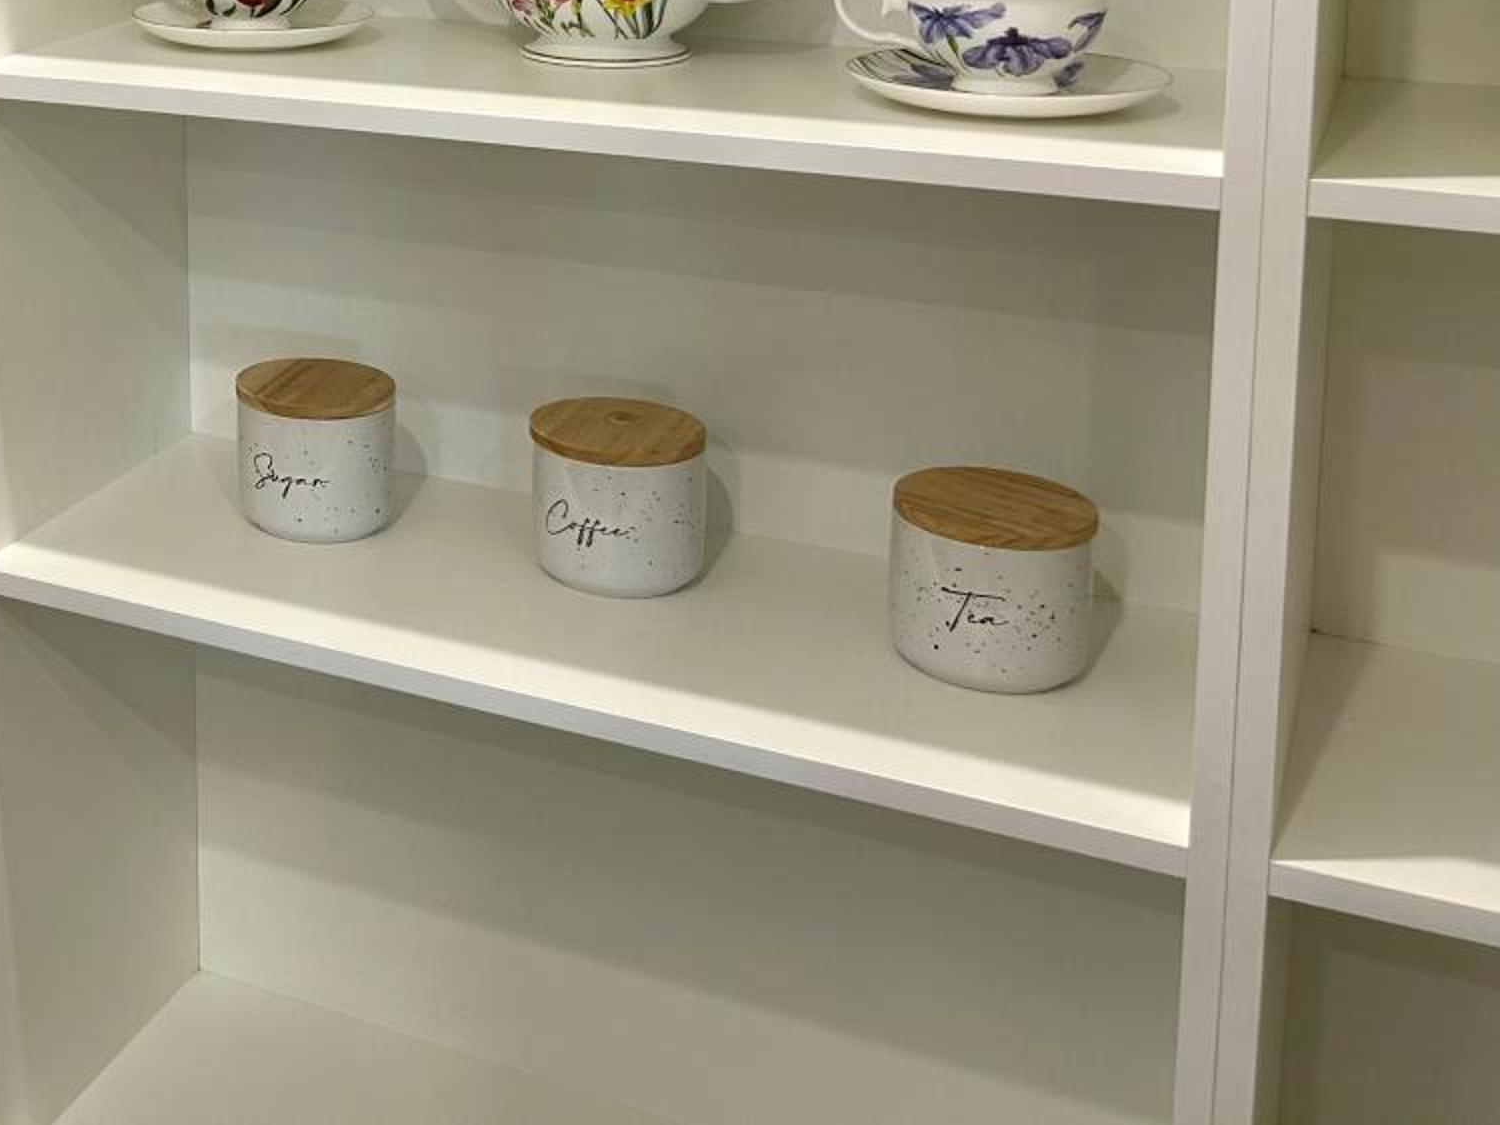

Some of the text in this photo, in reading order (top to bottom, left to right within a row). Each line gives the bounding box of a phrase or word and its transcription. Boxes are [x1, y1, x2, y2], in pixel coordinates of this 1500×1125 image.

[253, 452, 330, 499] Sugar
[545, 499, 631, 548] Coffee
[941, 586, 1009, 632] Tea
